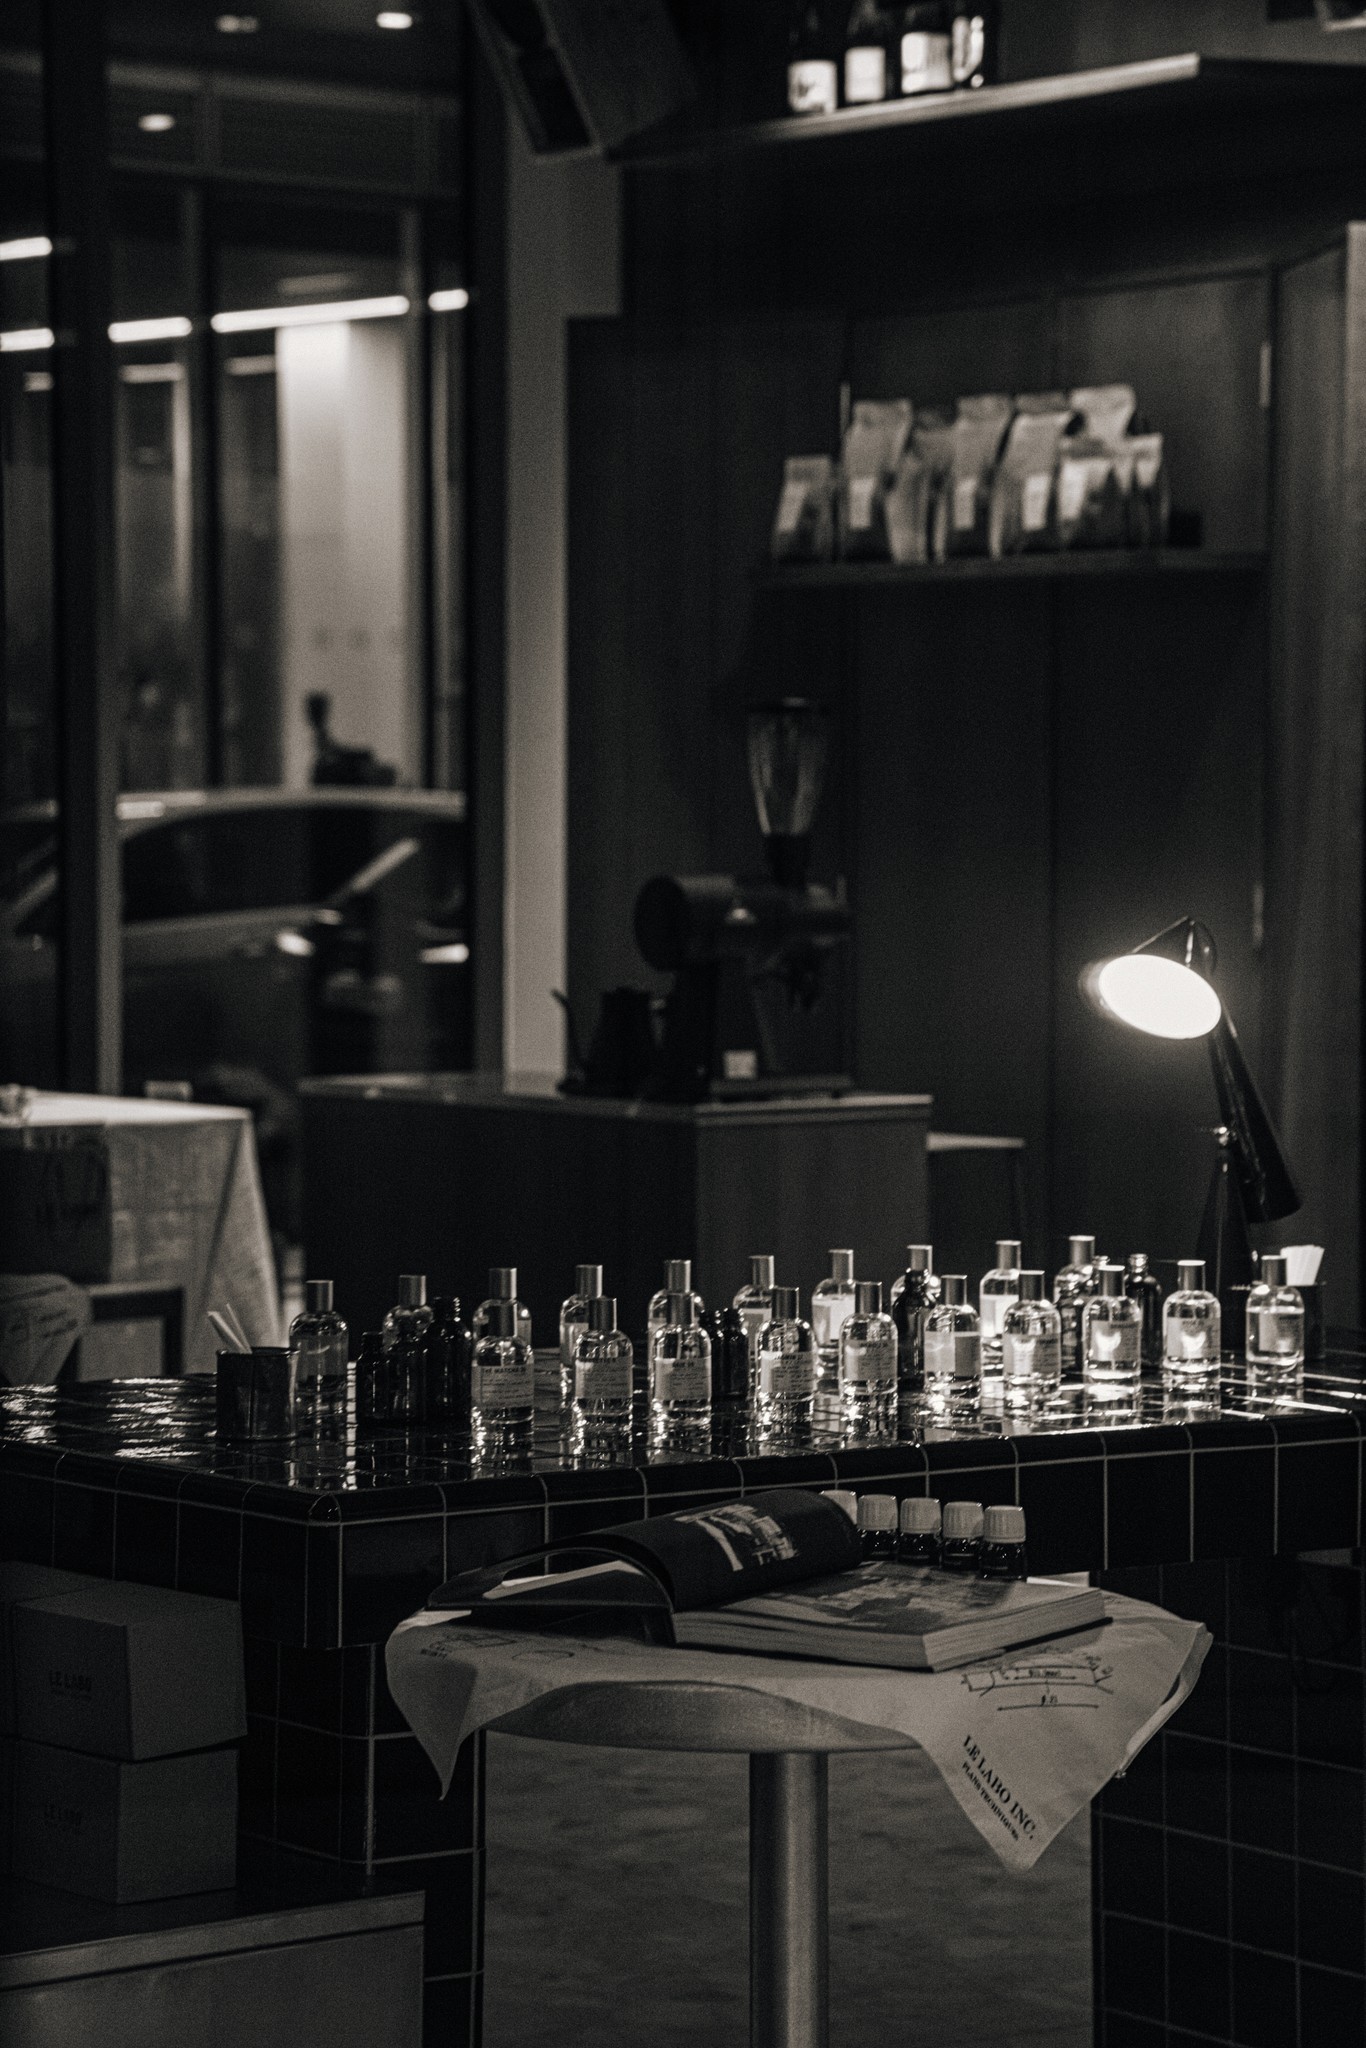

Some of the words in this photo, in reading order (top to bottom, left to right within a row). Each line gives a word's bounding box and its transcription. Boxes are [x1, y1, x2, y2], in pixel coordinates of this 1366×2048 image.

[963, 1735, 980, 1762] LE
[978, 1757, 1011, 1804] LABO
[1010, 1801, 1036, 1840] INC.
